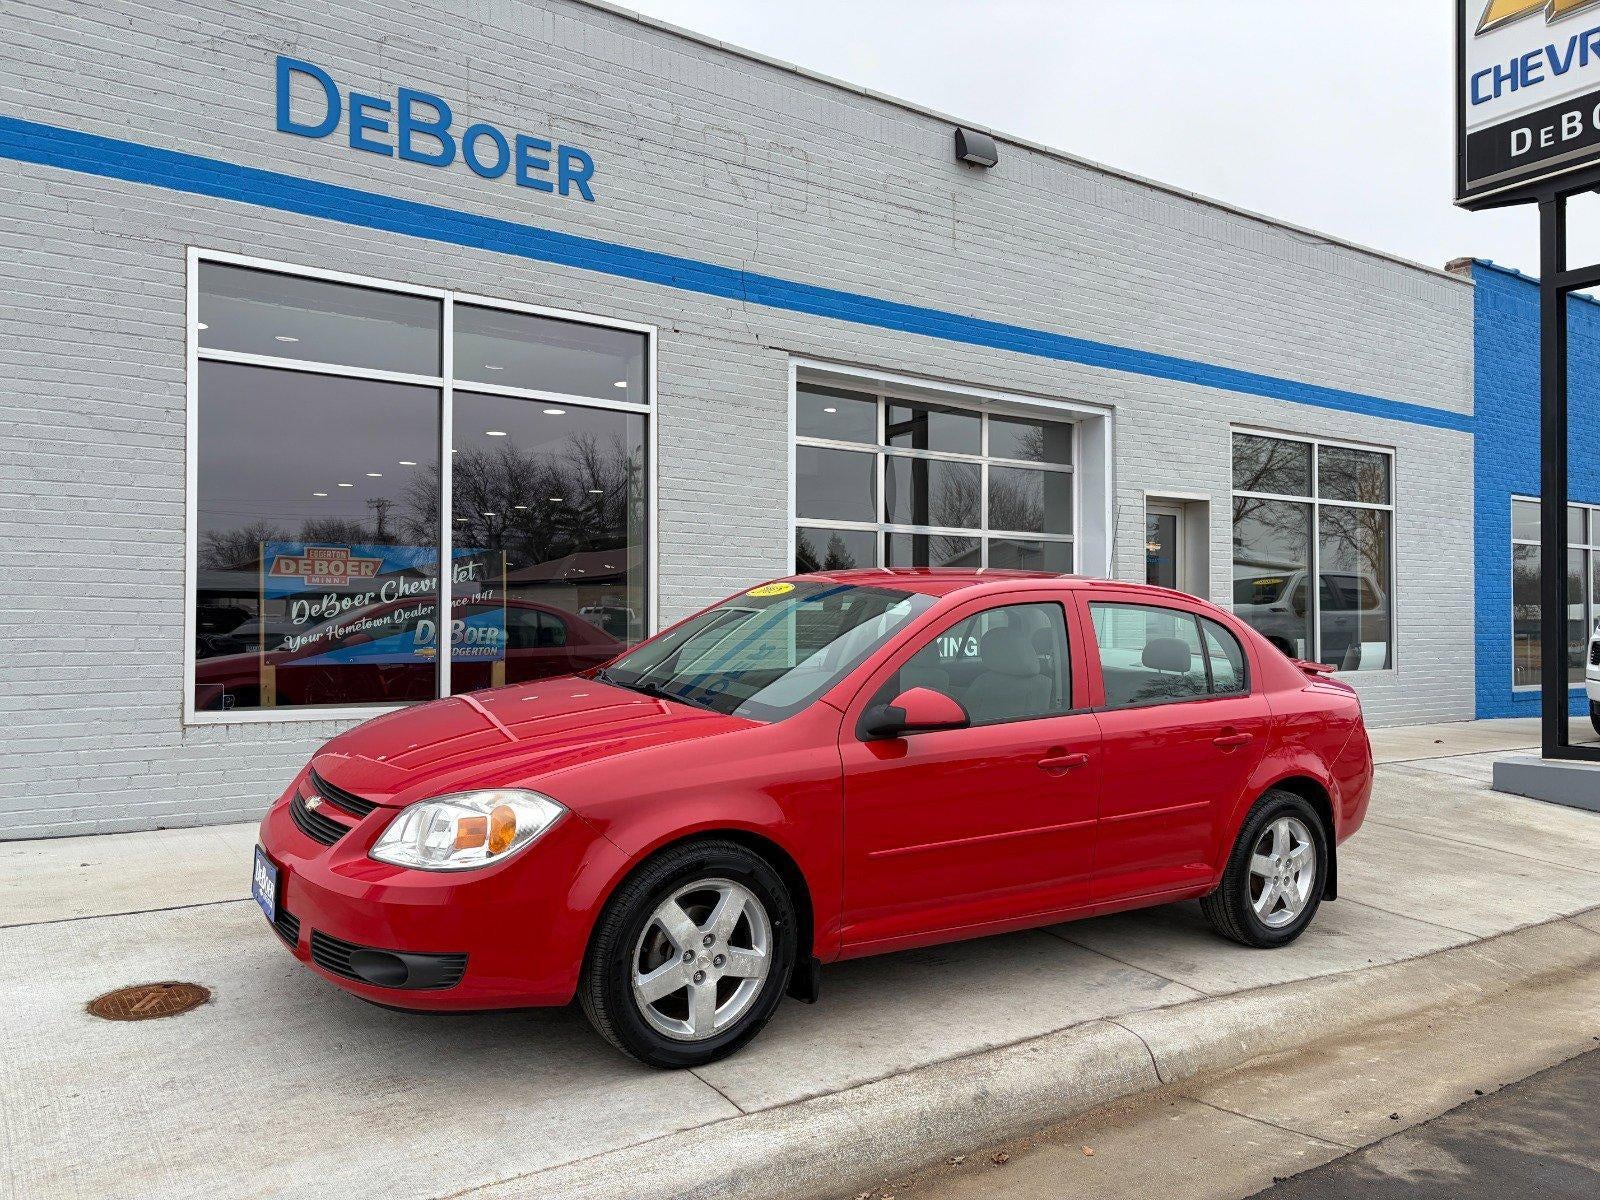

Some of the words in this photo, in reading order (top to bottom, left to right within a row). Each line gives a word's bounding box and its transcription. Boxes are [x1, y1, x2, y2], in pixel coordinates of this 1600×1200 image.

[309, 549, 348, 559] EDGERTON
[280, 559, 375, 576] DEBOER
[291, 592, 376, 626] DeBoer
[380, 560, 484, 604] Chevrlet
[284, 635, 324, 653] Your
[325, 616, 391, 641] Hometown
[394, 602, 435, 624] Dealer
[471, 589, 494, 605] 1947
[450, 646, 498, 657] DGERTON
